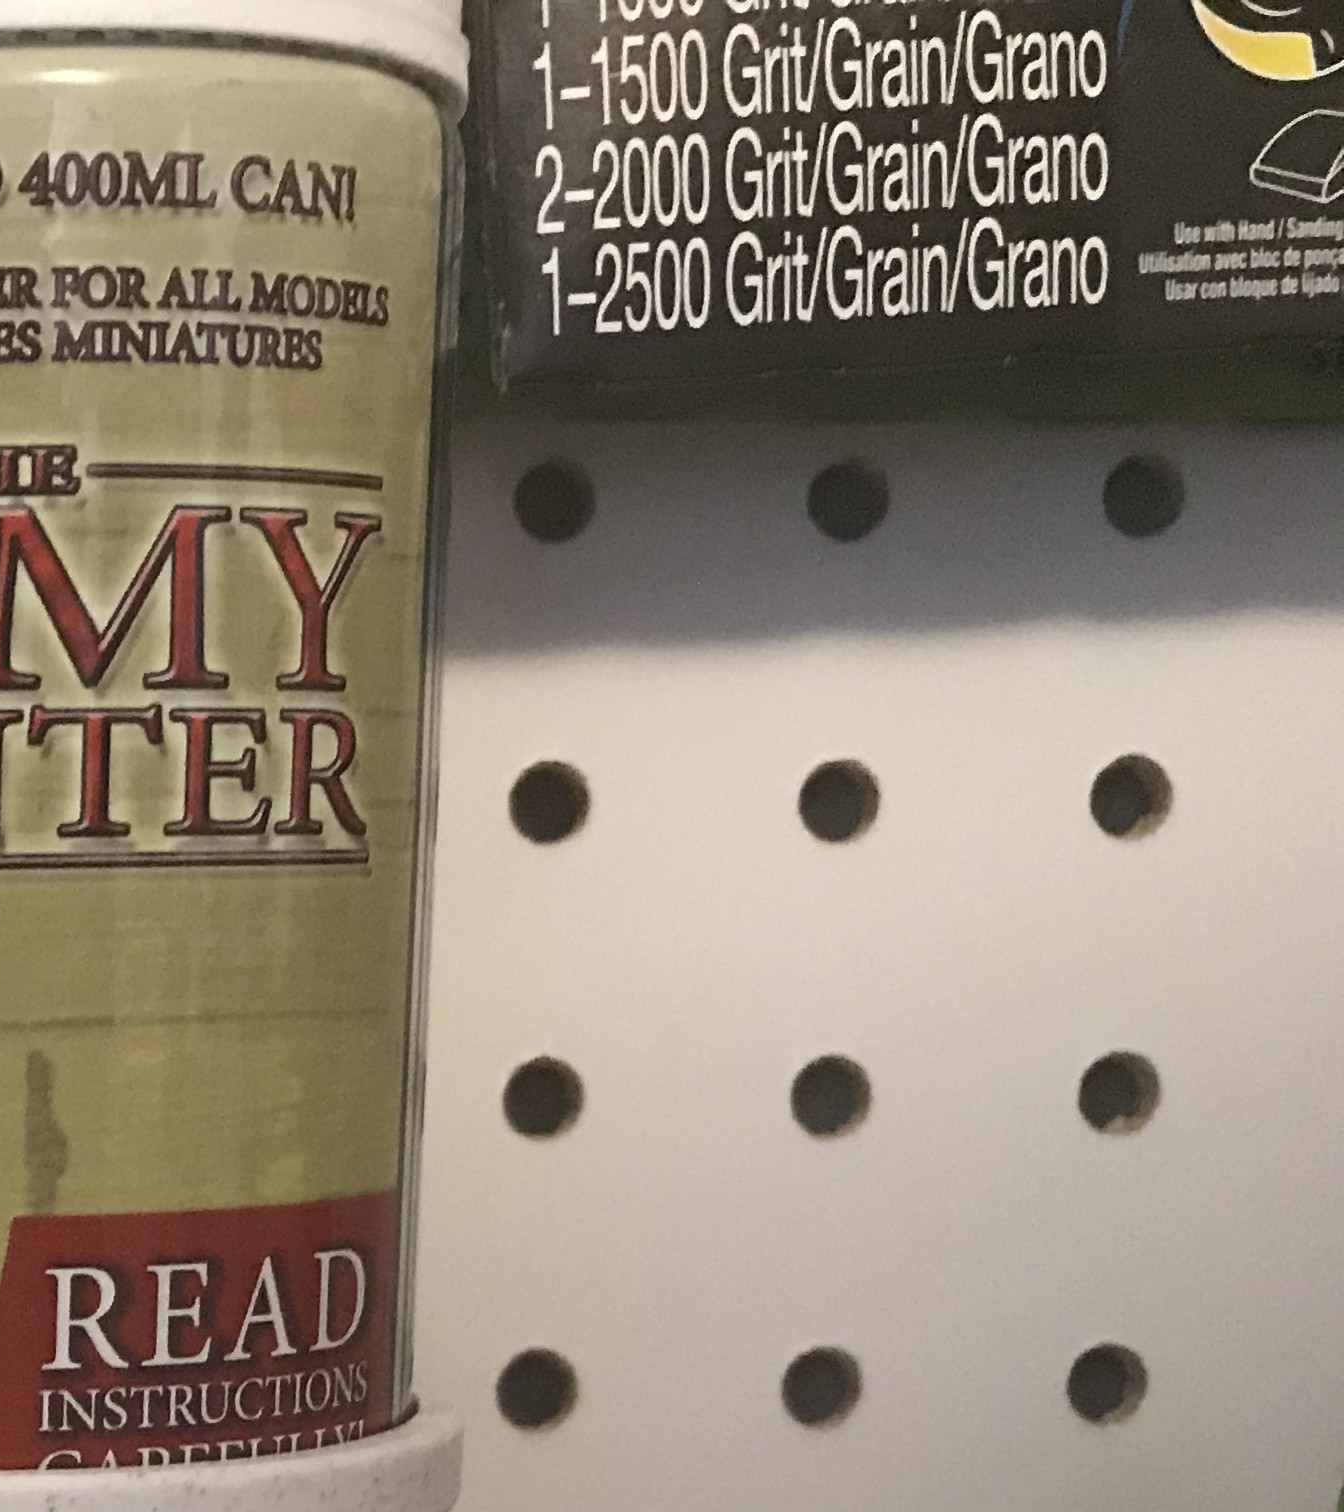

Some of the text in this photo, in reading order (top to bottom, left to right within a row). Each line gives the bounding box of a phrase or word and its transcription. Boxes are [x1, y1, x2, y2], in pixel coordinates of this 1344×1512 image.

[532, 9, 1109, 131] 1-1500 Grit/Grain/Grano
[18, 151, 216, 209] 400ML
[231, 156, 359, 223] CAN!
[534, 113, 1110, 235] 2-2000 Grit/Grain/Grano
[1238, 219, 1275, 240] Hand
[53, 266, 148, 310] FOR
[158, 269, 241, 312] ALL
[252, 273, 389, 328] MODELS
[542, 217, 1110, 337] 1-2500 Grit/Grain/Grano
[52, 321, 323, 371] MINIATURES
[41, 1247, 368, 1371] READ
[37, 1361, 369, 1433] INSTRUCTIONS
